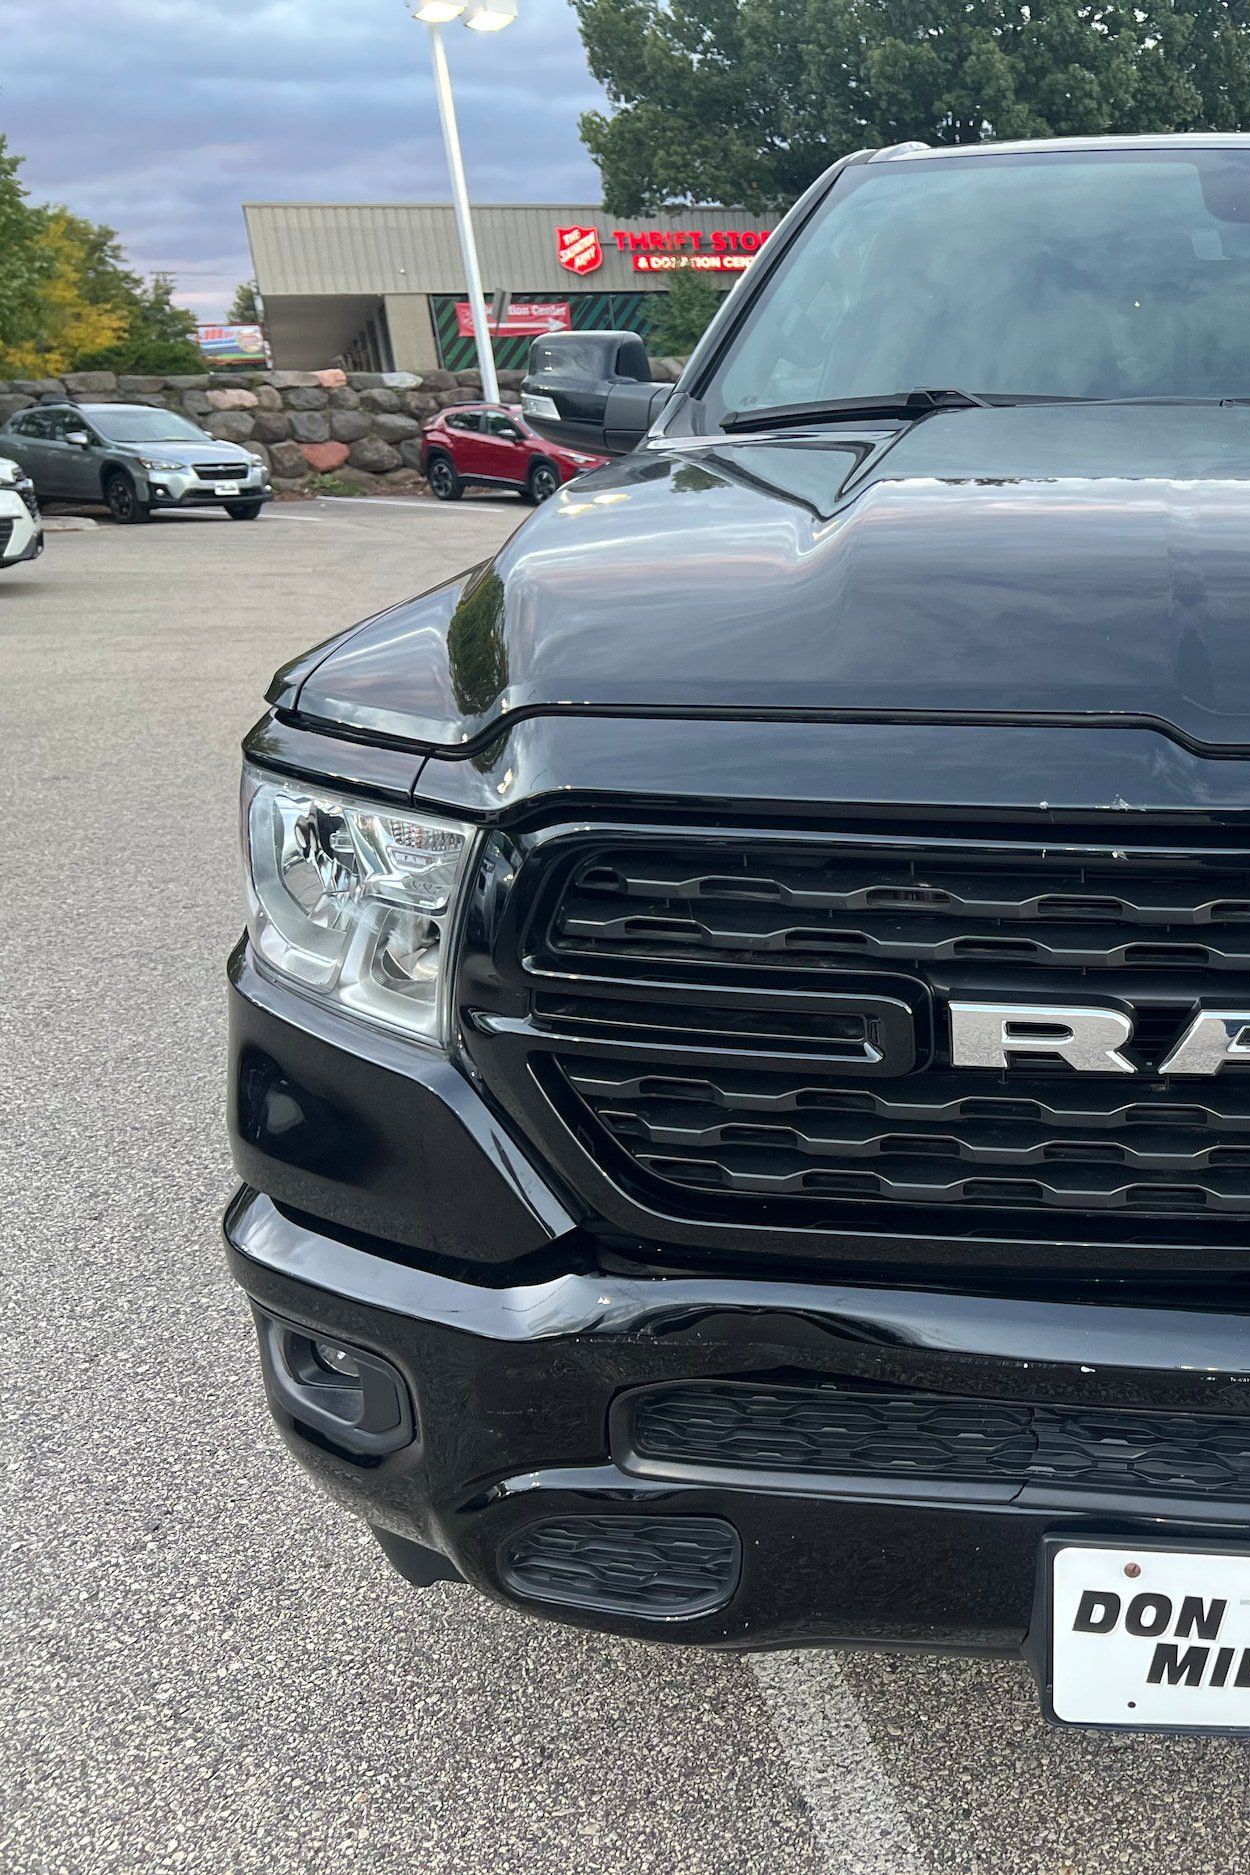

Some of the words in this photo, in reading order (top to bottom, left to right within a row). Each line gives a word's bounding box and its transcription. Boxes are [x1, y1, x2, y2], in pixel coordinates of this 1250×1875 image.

[562, 228, 581, 246] THE
[611, 230, 703, 251] THRIFT
[574, 245, 596, 270] ARMY
[637, 256, 649, 269] &
[1071, 1590, 1228, 1641] DON
